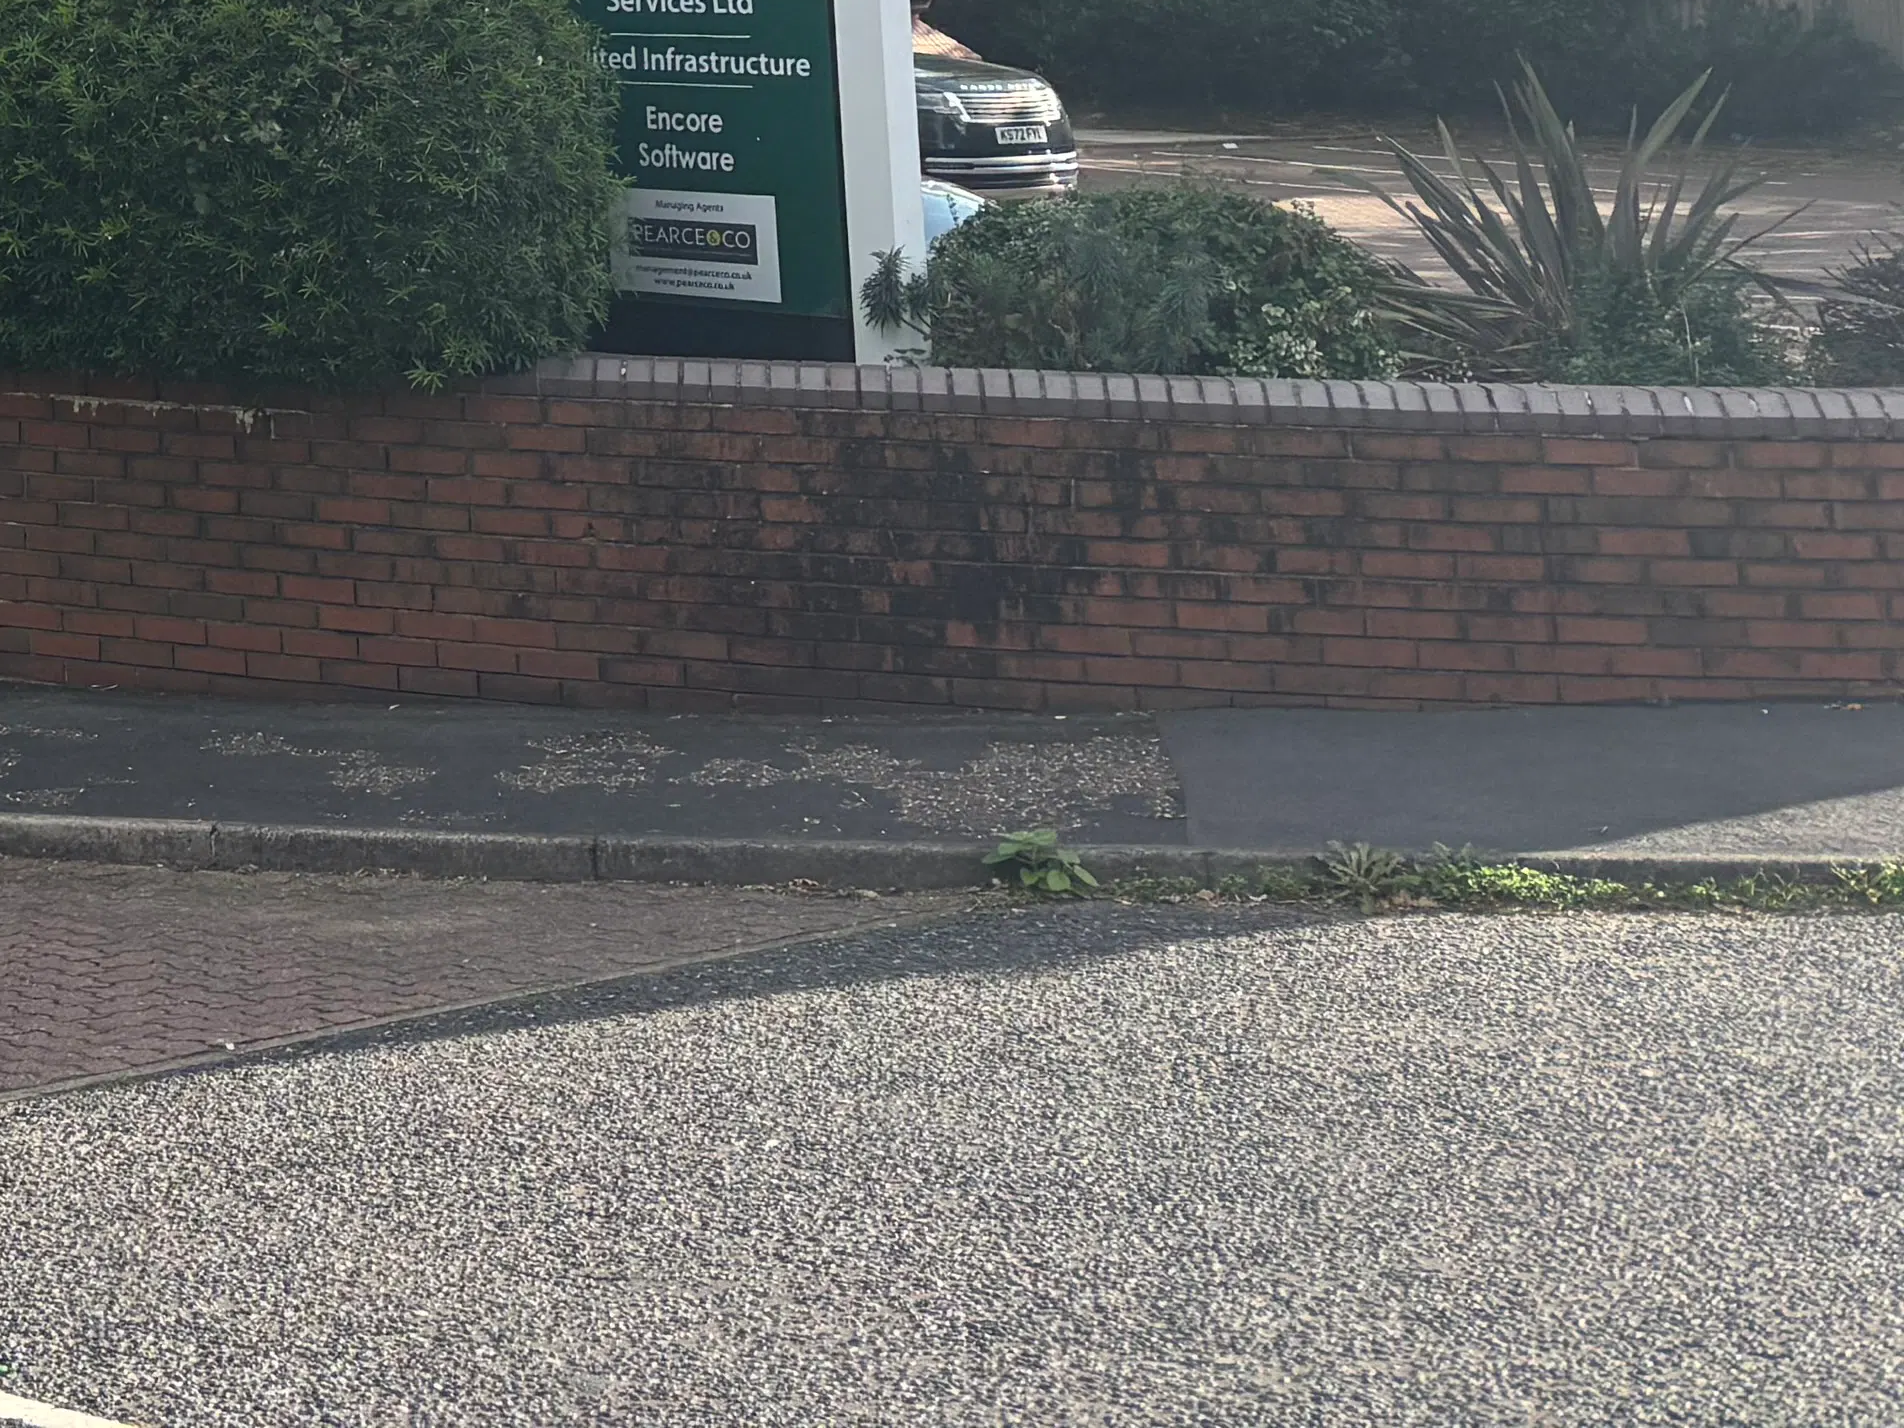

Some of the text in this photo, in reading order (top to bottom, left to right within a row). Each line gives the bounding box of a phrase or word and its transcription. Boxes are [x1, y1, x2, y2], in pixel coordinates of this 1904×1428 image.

[643, 46, 811, 77] Infrastructure
[645, 105, 724, 134] Encore
[638, 142, 735, 172] Software
[655, 200, 724, 213] Managing Agents
